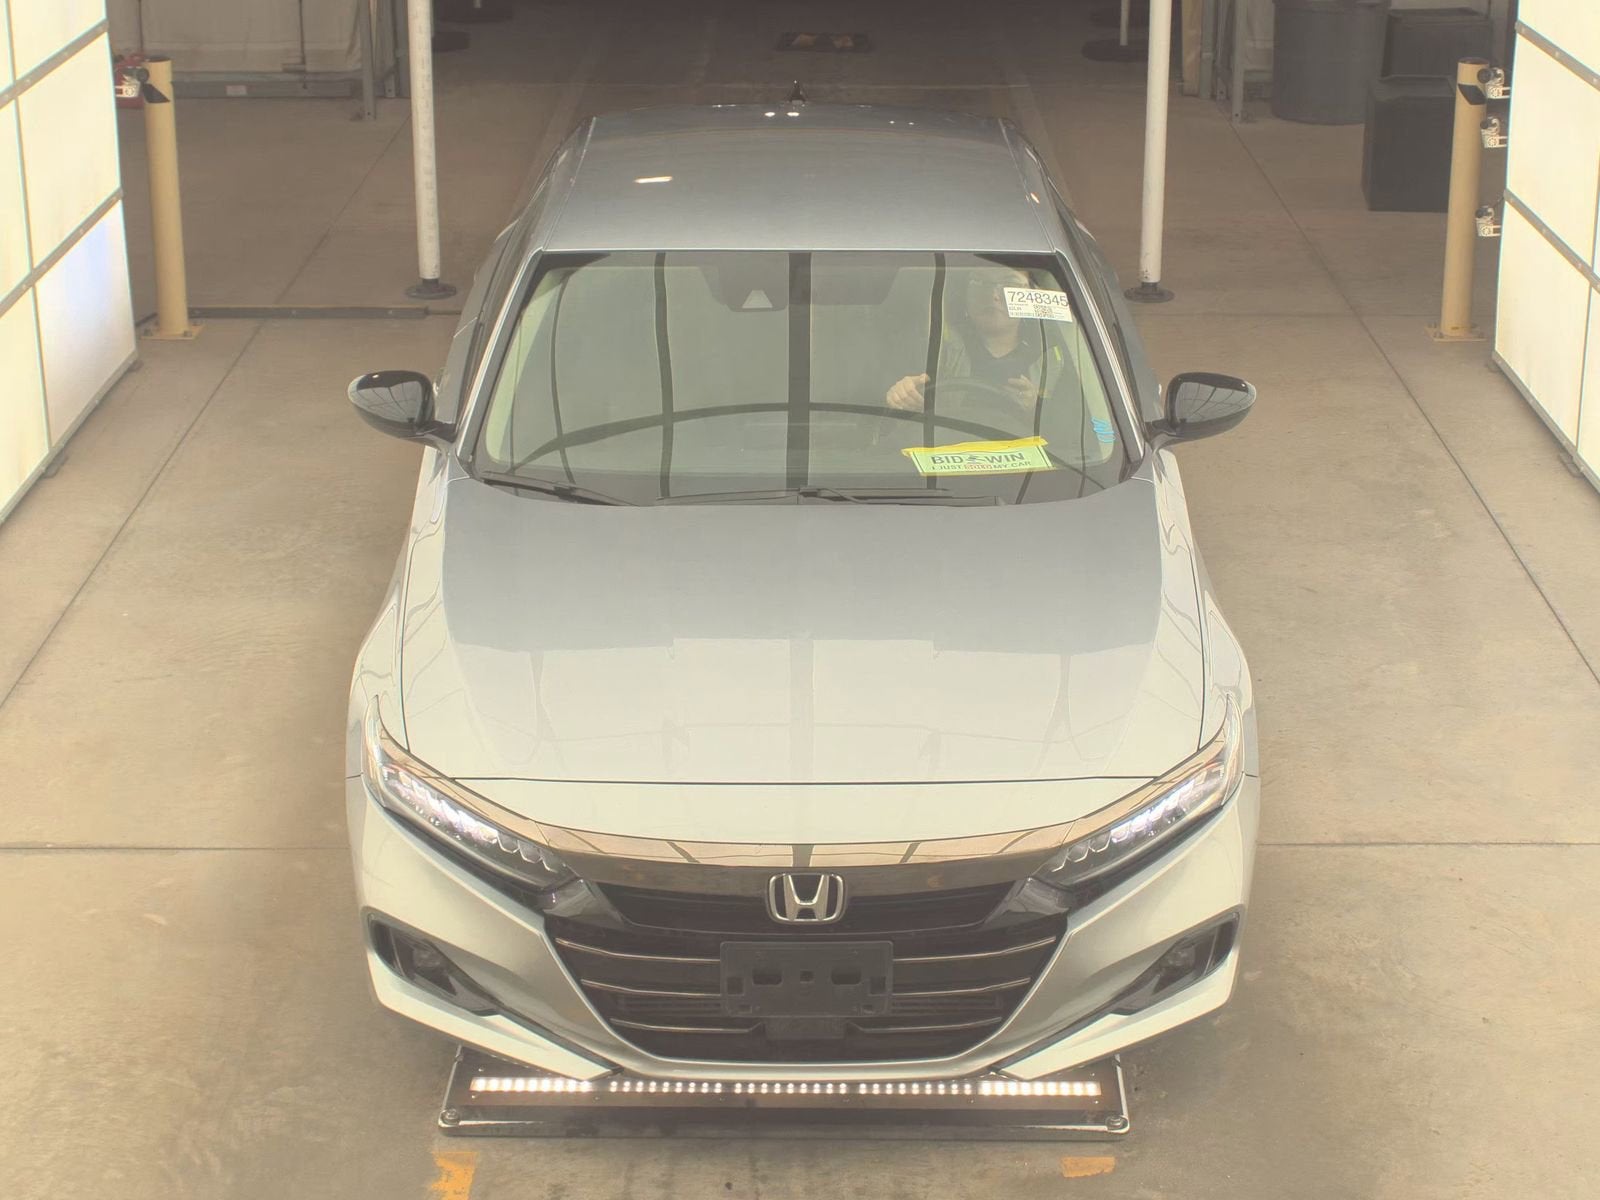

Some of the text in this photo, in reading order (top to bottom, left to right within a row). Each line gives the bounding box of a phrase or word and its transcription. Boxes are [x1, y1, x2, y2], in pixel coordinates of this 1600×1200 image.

[1008, 291, 1069, 307] 7248345
[930, 452, 1025, 464] BID WIN
